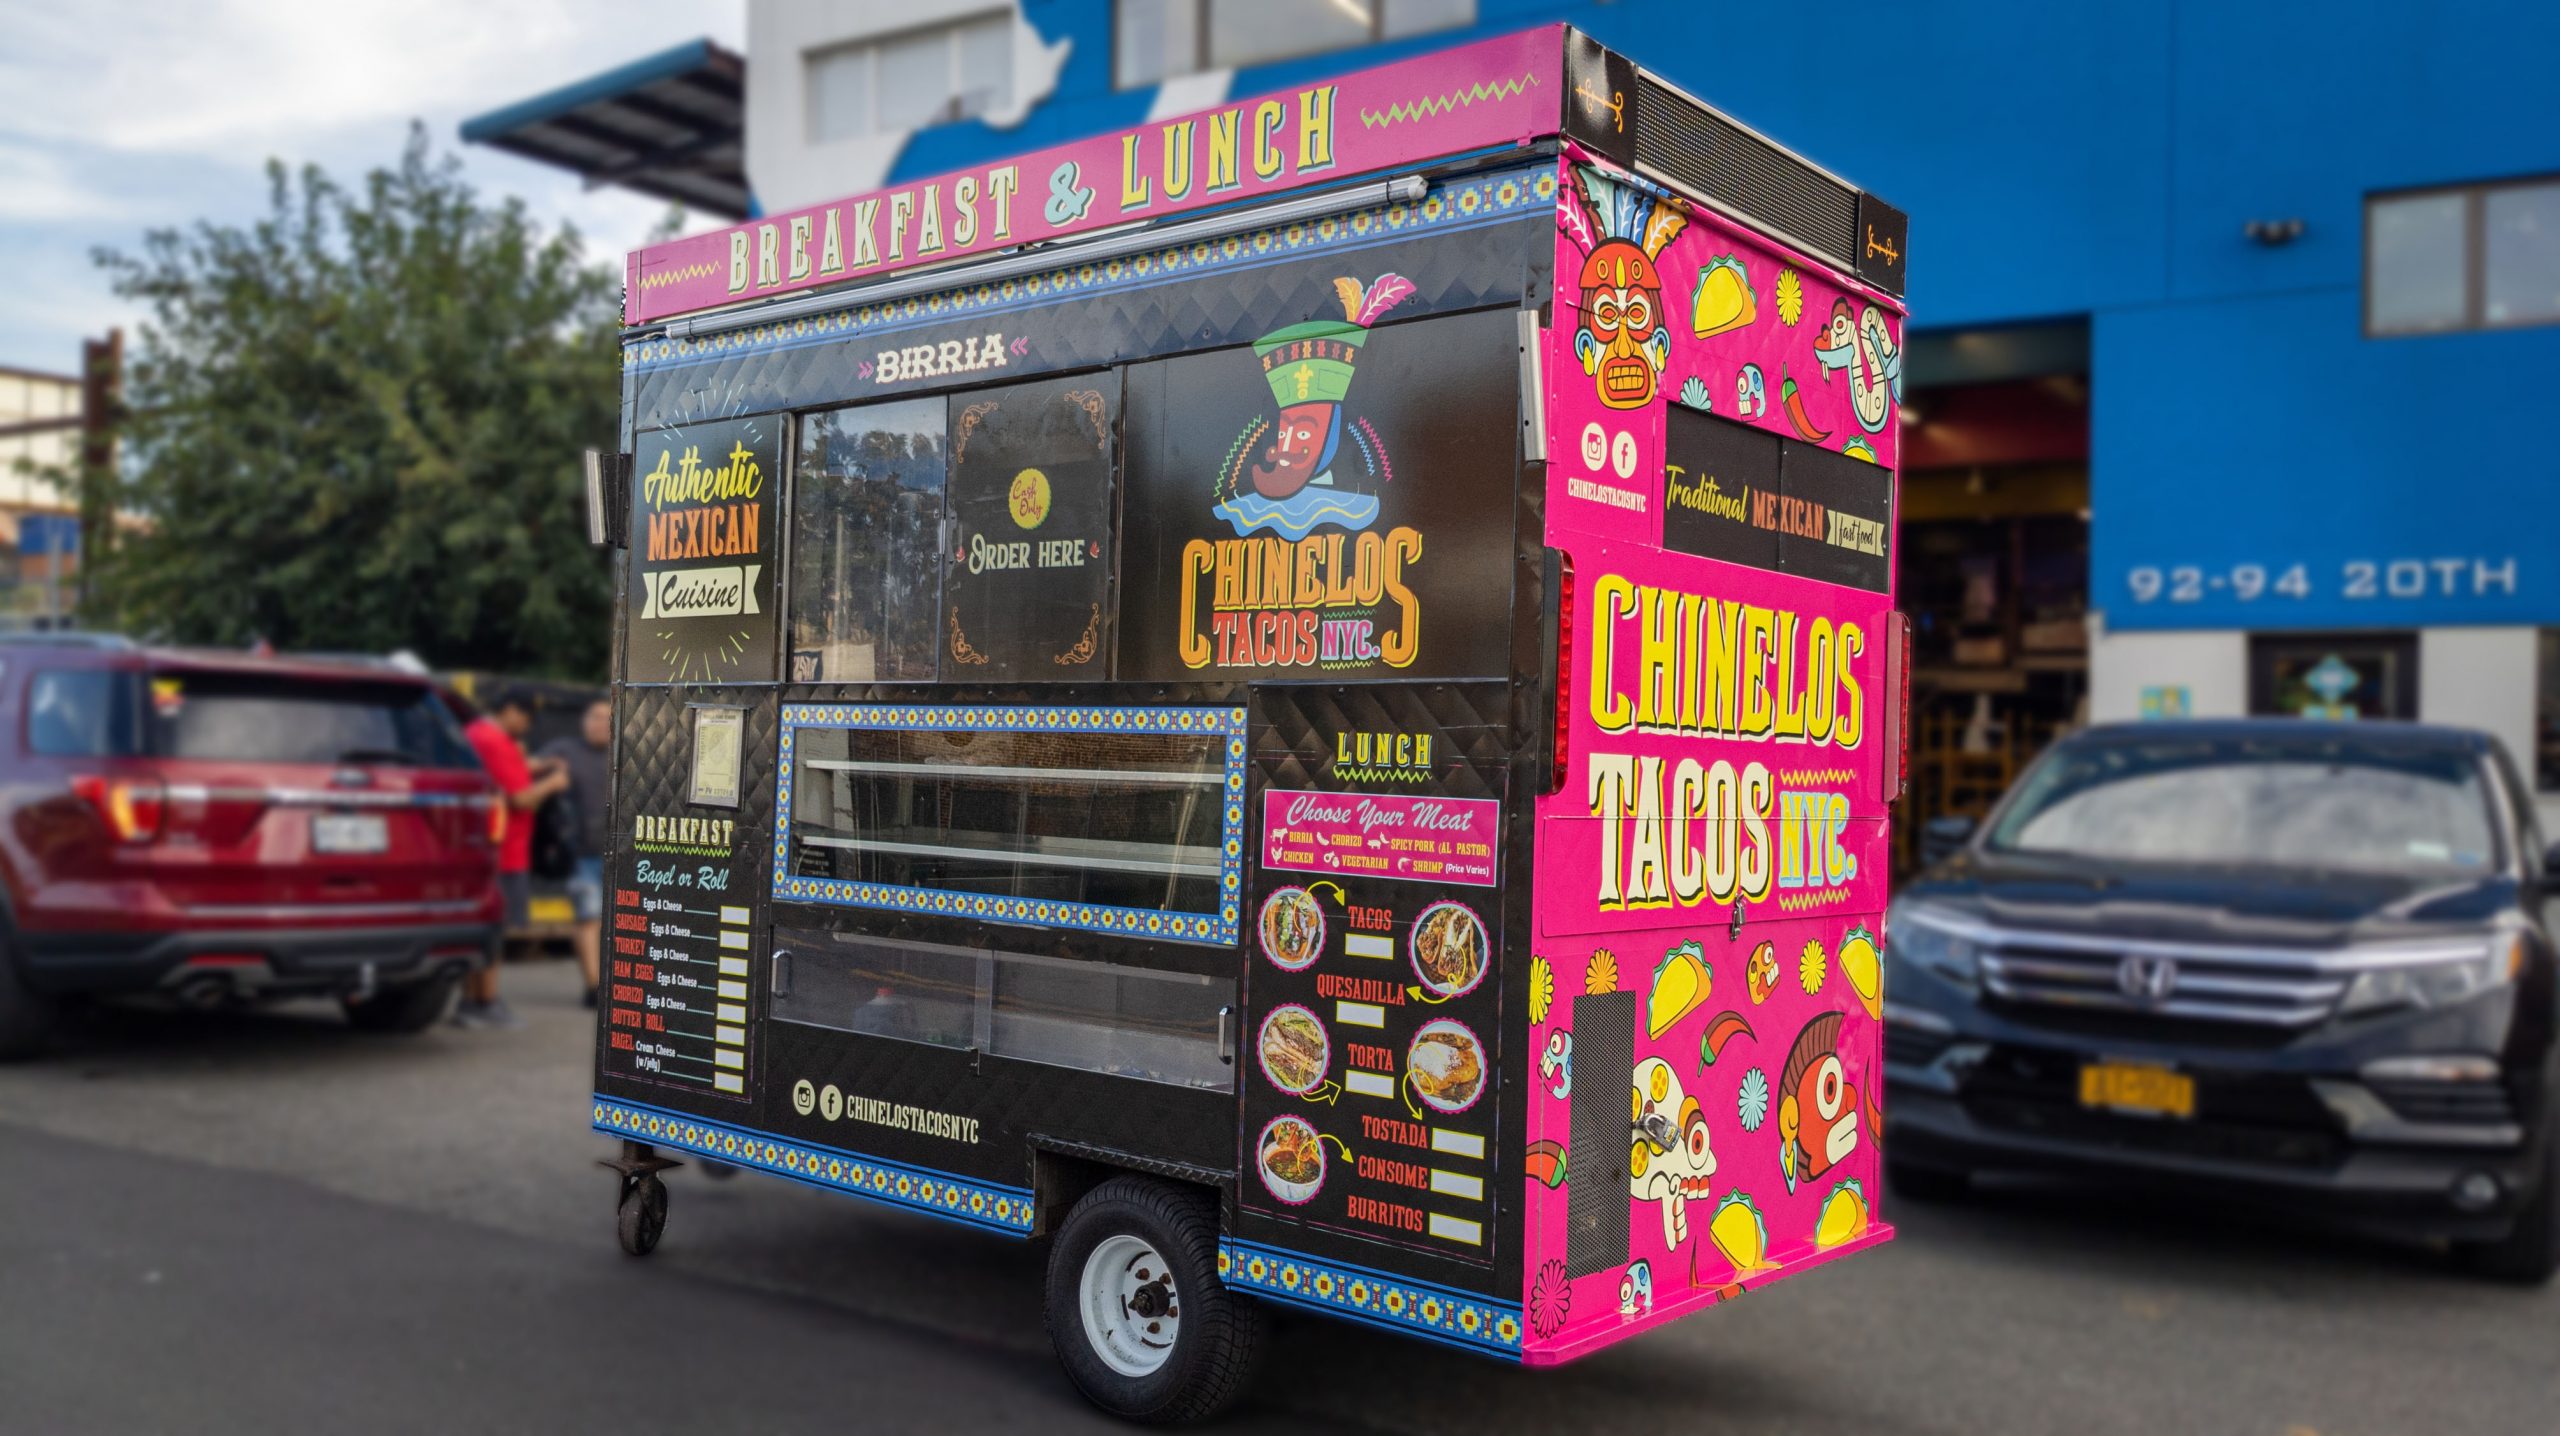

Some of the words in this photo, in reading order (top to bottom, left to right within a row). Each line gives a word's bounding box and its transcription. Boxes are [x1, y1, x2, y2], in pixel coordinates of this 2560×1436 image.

[728, 165, 1018, 294] BREAKFAST
[1044, 162, 1097, 226] &
[1120, 86, 1338, 213] LUNCH
[875, 333, 1007, 384] BIRRIA
[644, 440, 763, 513] Authentic
[1013, 477, 1036, 500] Cash
[1020, 497, 1043, 521] Only
[1568, 477, 1646, 513] CHINELOSTACOSNYC
[1665, 464, 1749, 524] Traditional
[1752, 488, 1824, 541] MEXICAN
[647, 502, 760, 562] MEXICAN
[968, 533, 1031, 575] ORDER
[1038, 539, 1085, 568] HERE
[661, 574, 739, 612] Cuisine
[1179, 526, 1423, 670] CHINELOS
[2127, 564, 2311, 602] 92-94
[2341, 558, 2518, 600] 20TH
[1213, 610, 1319, 668] TACOS
[1320, 619, 1381, 662] NYC.
[1590, 573, 1864, 751] CHINELOS
[1337, 731, 1432, 769] LUNCH
[635, 815, 733, 846] BREAKFAST
[1286, 795, 1352, 826] Choose
[1356, 798, 1405, 834] Your
[1411, 801, 1474, 832] Meat
[1589, 752, 1774, 912] TACOS
[1778, 790, 1857, 889] NYC.
[1289, 831, 1314, 844] BIRRIA
[1331, 833, 1363, 847] CHORIZO
[1390, 838, 1413, 851] SPICY
[1414, 840, 1435, 853] PORK
[1438, 841, 1452, 855] (AL
[1456, 843, 1491, 858] PASTOR)
[637, 860, 676, 892] Bagel
[678, 872, 693, 887] or
[697, 866, 730, 891] Roll
[1283, 850, 1314, 864] CHICKEN
[1341, 854, 1389, 869] VEGETARIAN
[1412, 860, 1444, 873] SHRIMP
[1445, 863, 1464, 875] (Price
[1465, 864, 1489, 877] Varies)
[616, 889, 640, 907] BACON
[643, 897, 657, 912] Eggs
[662, 900, 682, 912] Cheese
[1348, 905, 1392, 931] TACOS
[616, 913, 647, 932] SAUSAGE
[651, 922, 665, 937] Eggs
[670, 925, 690, 937] Cheese
[615, 936, 646, 956] TURKEY
[649, 946, 663, 961] Eggs
[669, 949, 689, 962] Cheese
[614, 960, 631, 979] HAM
[635, 963, 654, 981] EGGS
[657, 972, 671, 987] Eggs
[677, 974, 698, 988] Cheese
[1317, 973, 1406, 1006] QUESADILLA
[613, 984, 644, 1004] CHORIZO
[646, 995, 660, 1009] Eggs
[666, 997, 686, 1011] Cheese
[612, 1008, 641, 1028] BUTTER
[645, 1012, 666, 1032] ROLL
[611, 1031, 634, 1051] BAGEL
[635, 1040, 654, 1054] Cream
[655, 1044, 676, 1058] Cheese
[1347, 1042, 1394, 1073] TORTA
[847, 1094, 979, 1144] CHINELOSTACOSNYC
[1361, 1114, 1428, 1149] TOSTADA
[1357, 1154, 1428, 1190] CONSOME
[1347, 1195, 1424, 1233] BURRITOS
